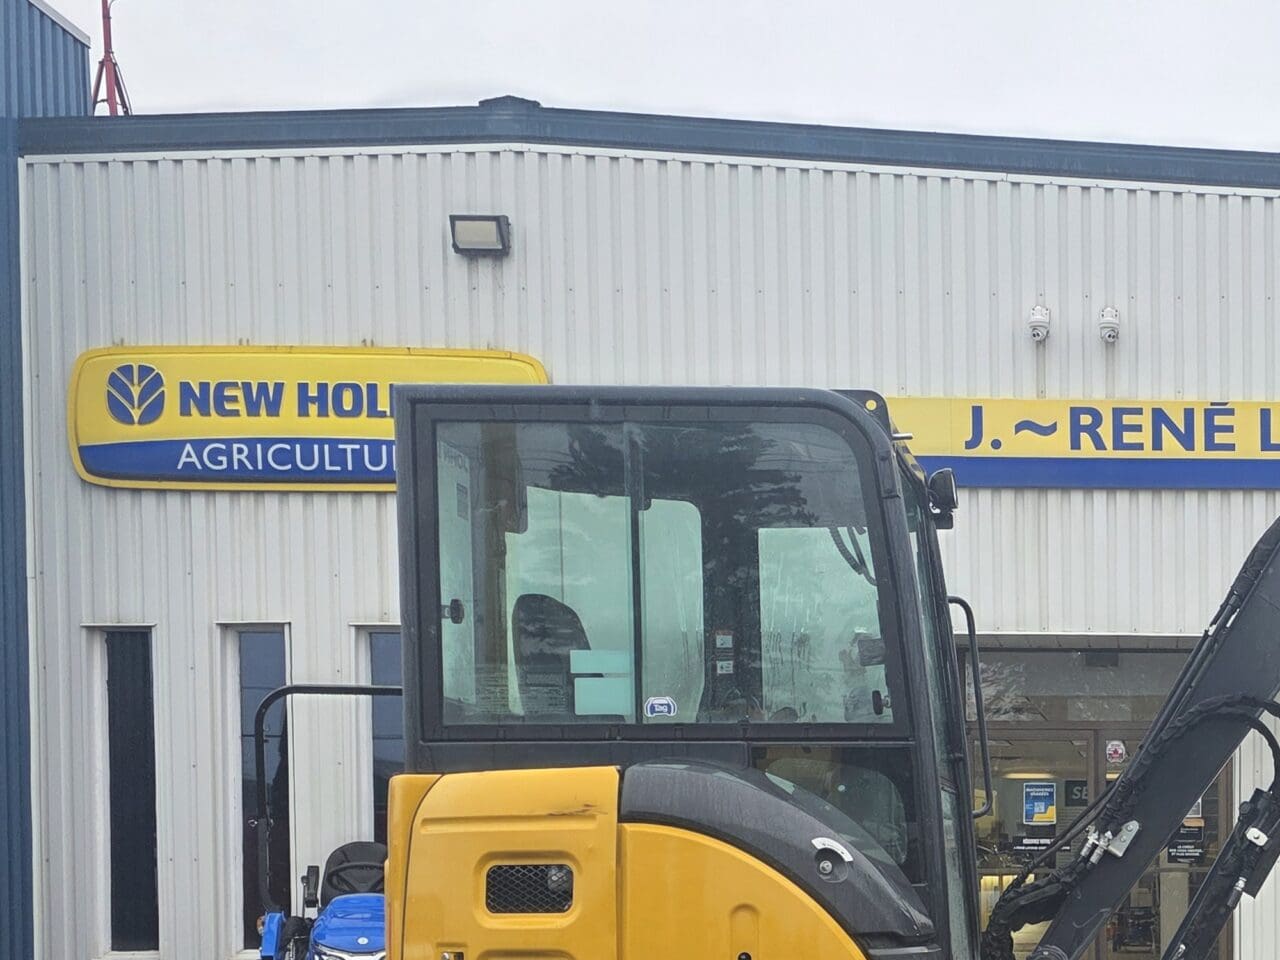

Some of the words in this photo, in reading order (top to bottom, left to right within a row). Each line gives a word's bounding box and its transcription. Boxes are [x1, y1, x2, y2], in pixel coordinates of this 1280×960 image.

[179, 381, 285, 417] NEW
[297, 382, 394, 418] HOL
[176, 443, 395, 471] AGRICULTU
